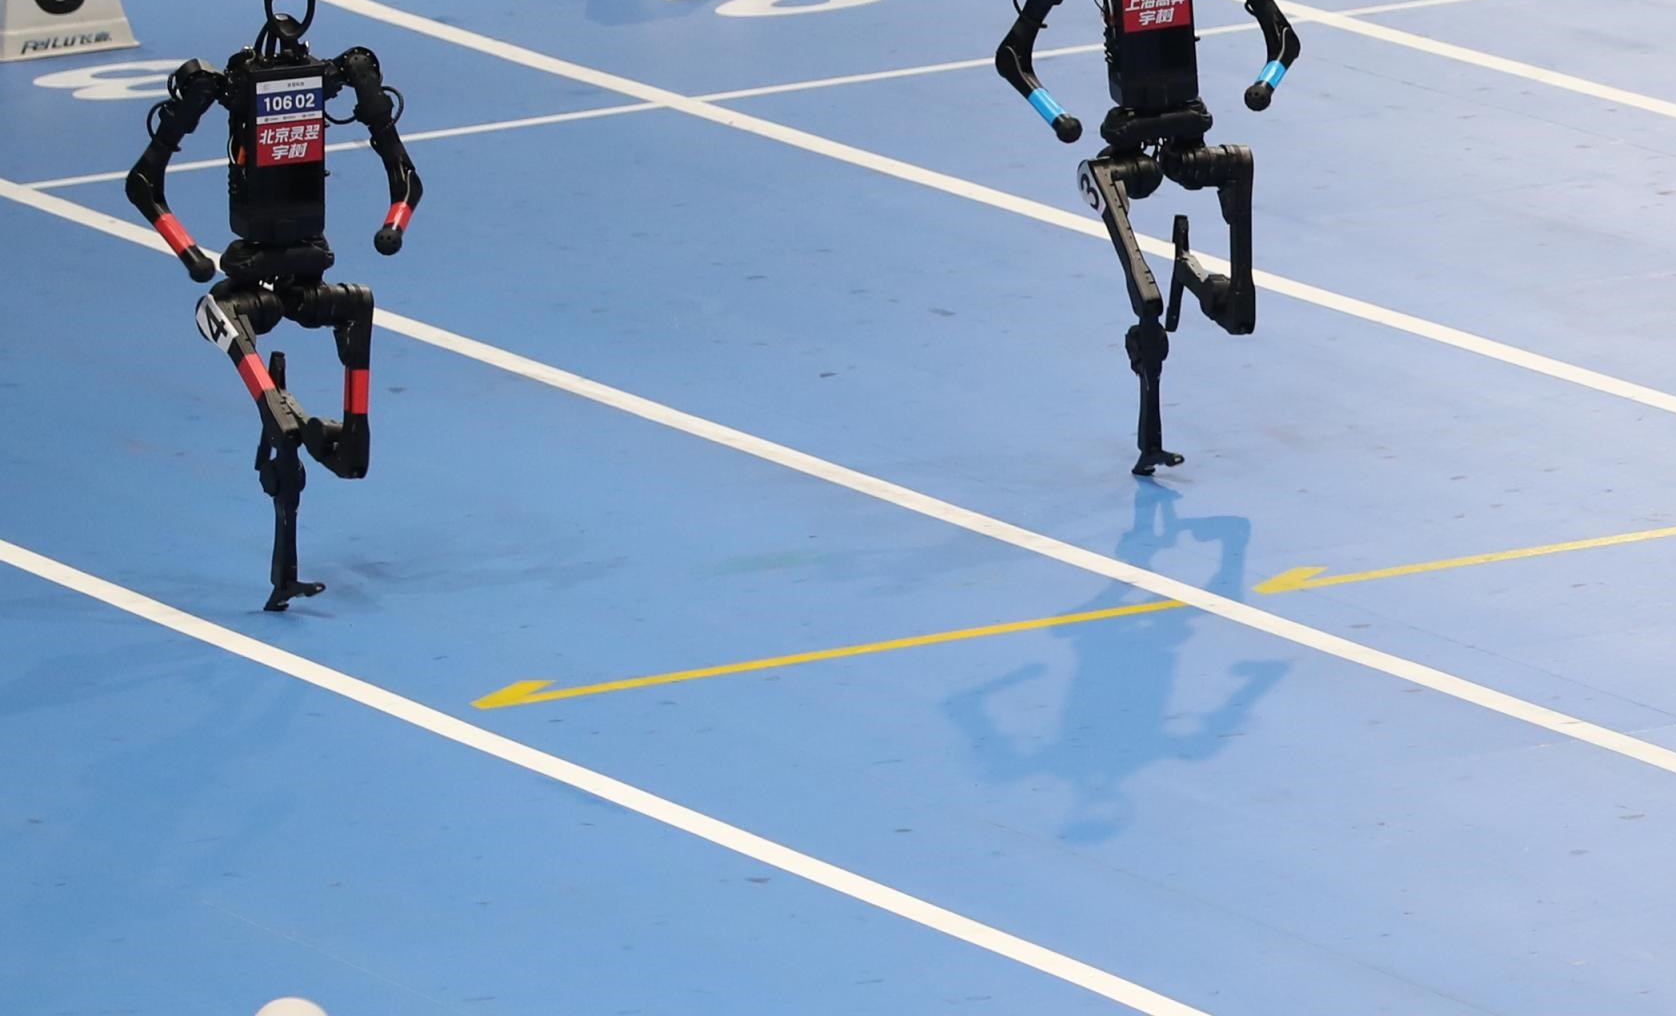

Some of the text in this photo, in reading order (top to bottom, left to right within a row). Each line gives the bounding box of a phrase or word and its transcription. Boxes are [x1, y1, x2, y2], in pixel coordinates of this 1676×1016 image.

[1138, 7, 1175, 26] 宇树
[263, 93, 315, 112] 106 02
[271, 142, 308, 160] 宇树
[1080, 173, 1100, 211] 3
[205, 303, 228, 343] 4
